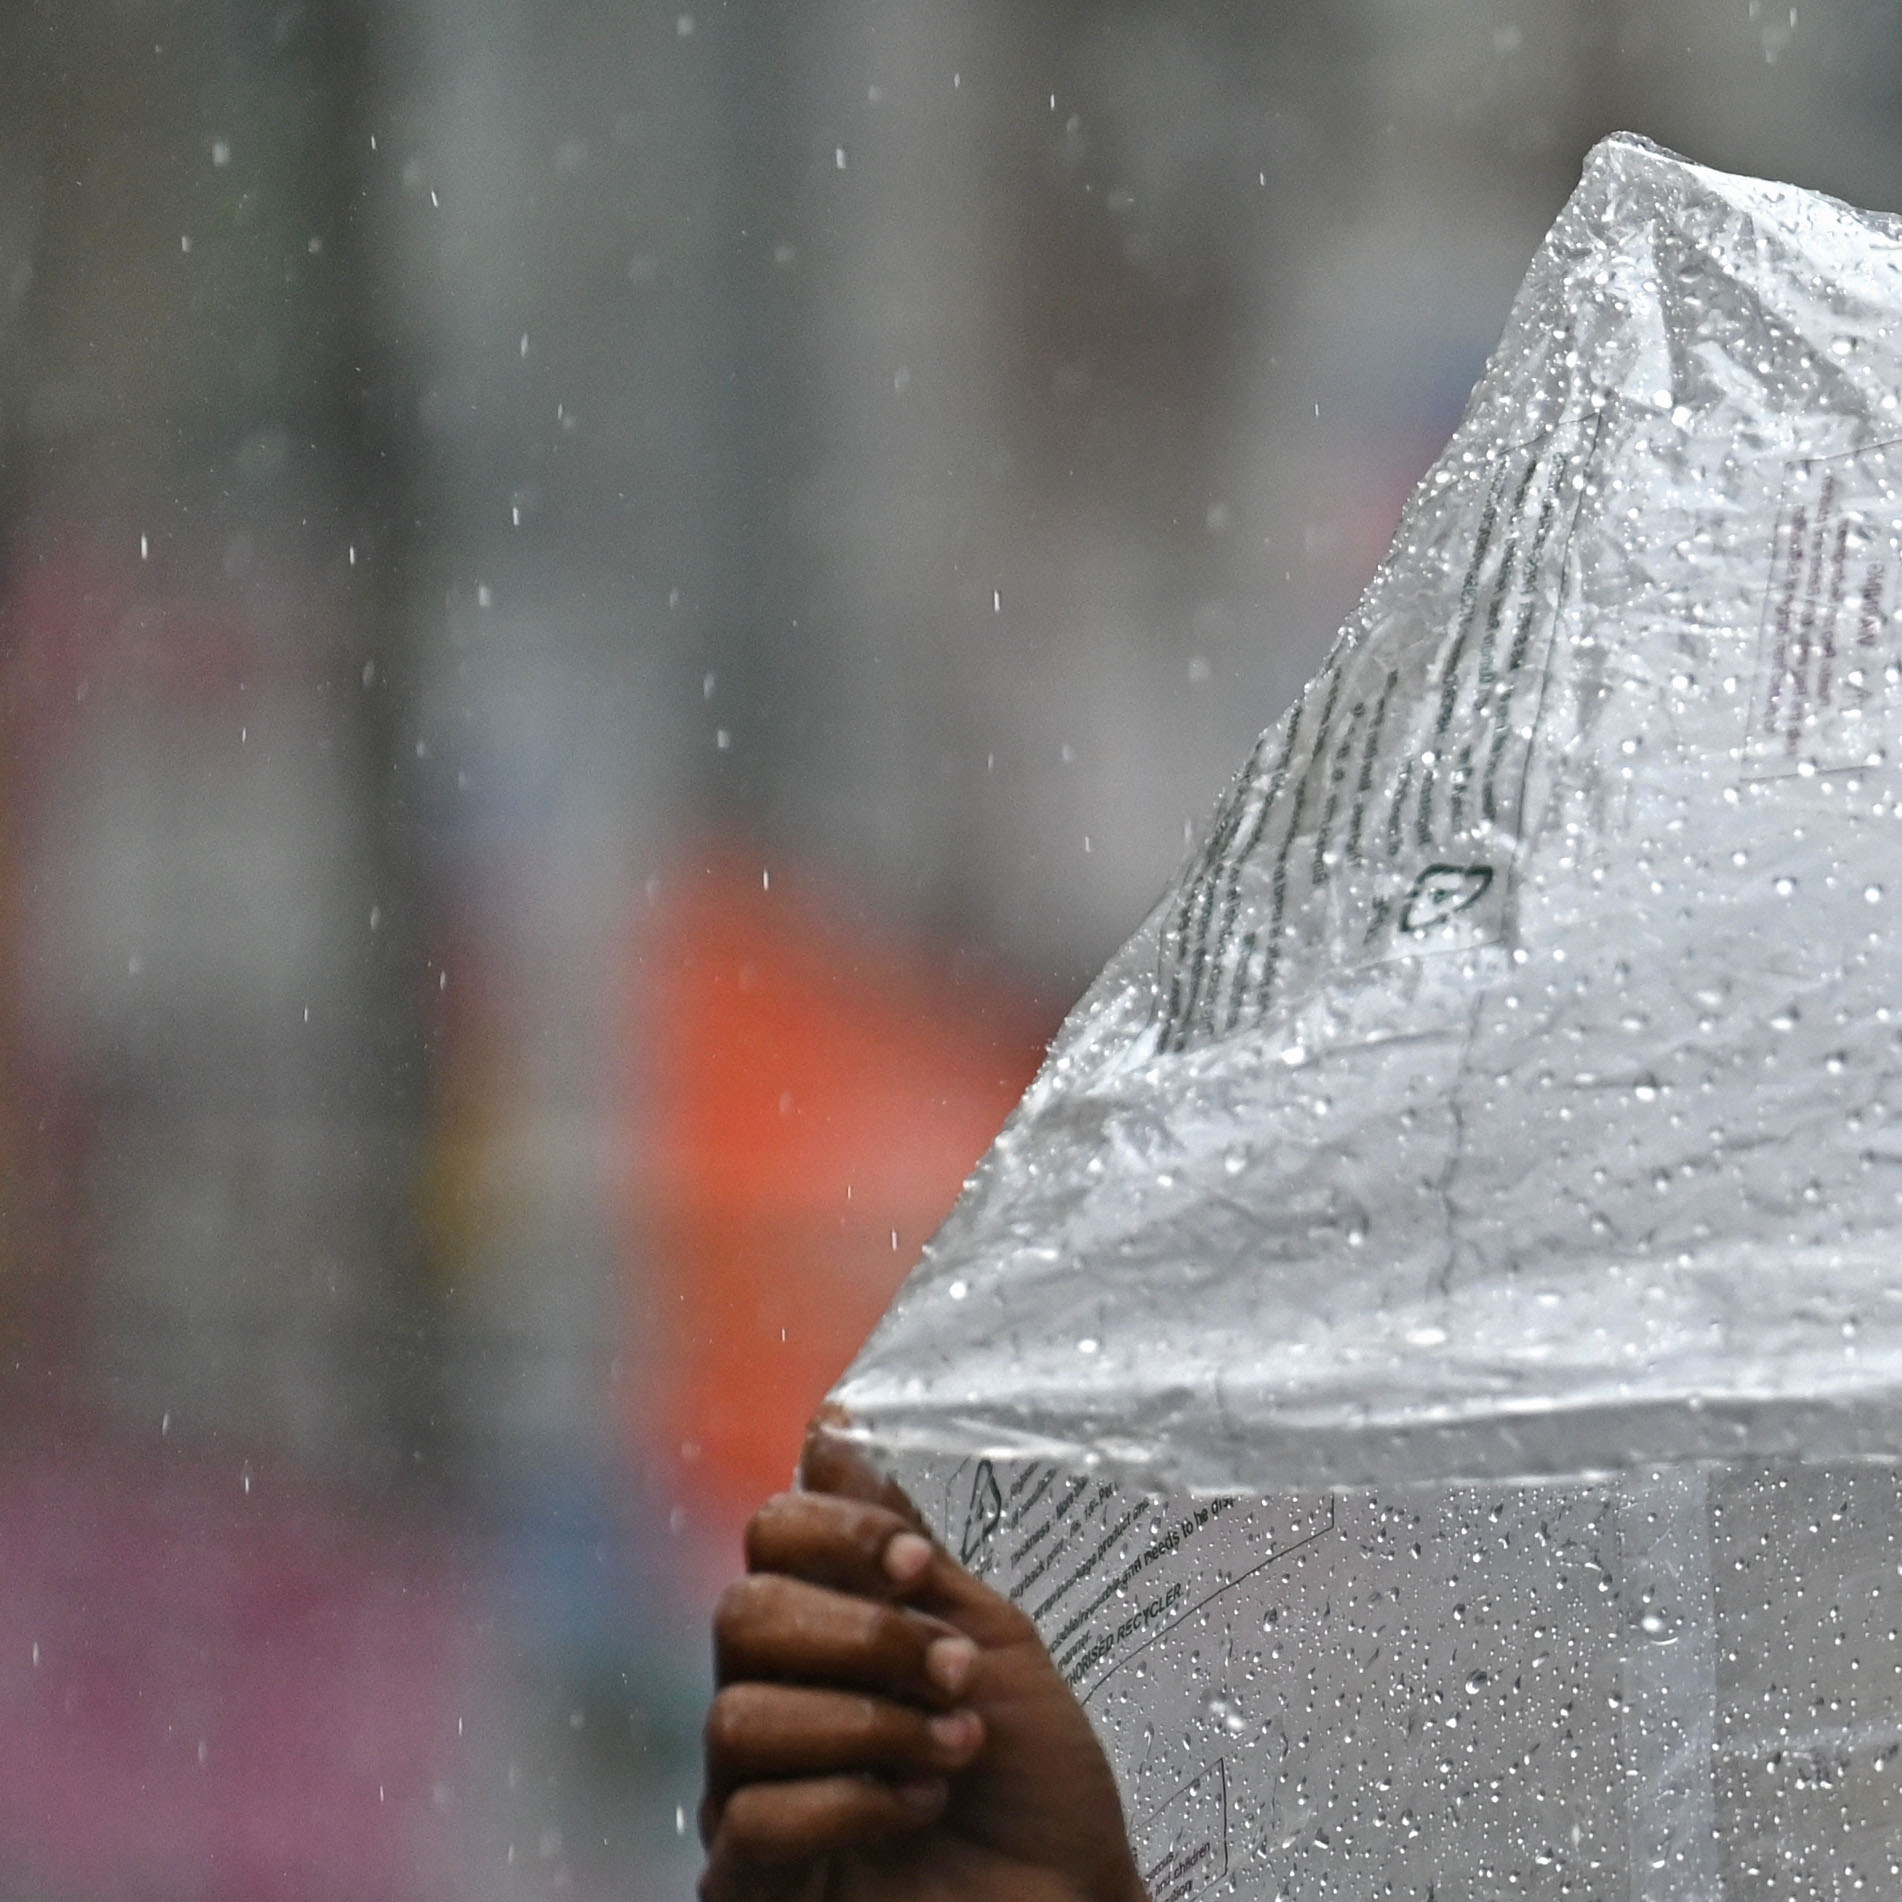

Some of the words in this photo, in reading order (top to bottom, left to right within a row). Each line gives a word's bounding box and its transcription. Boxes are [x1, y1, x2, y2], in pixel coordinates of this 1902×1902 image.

[1144, 1531, 1181, 1567] needs
[1181, 1521, 1195, 1539] to
[1194, 1507, 1209, 1528] be
[1173, 1842, 1210, 1879] children
